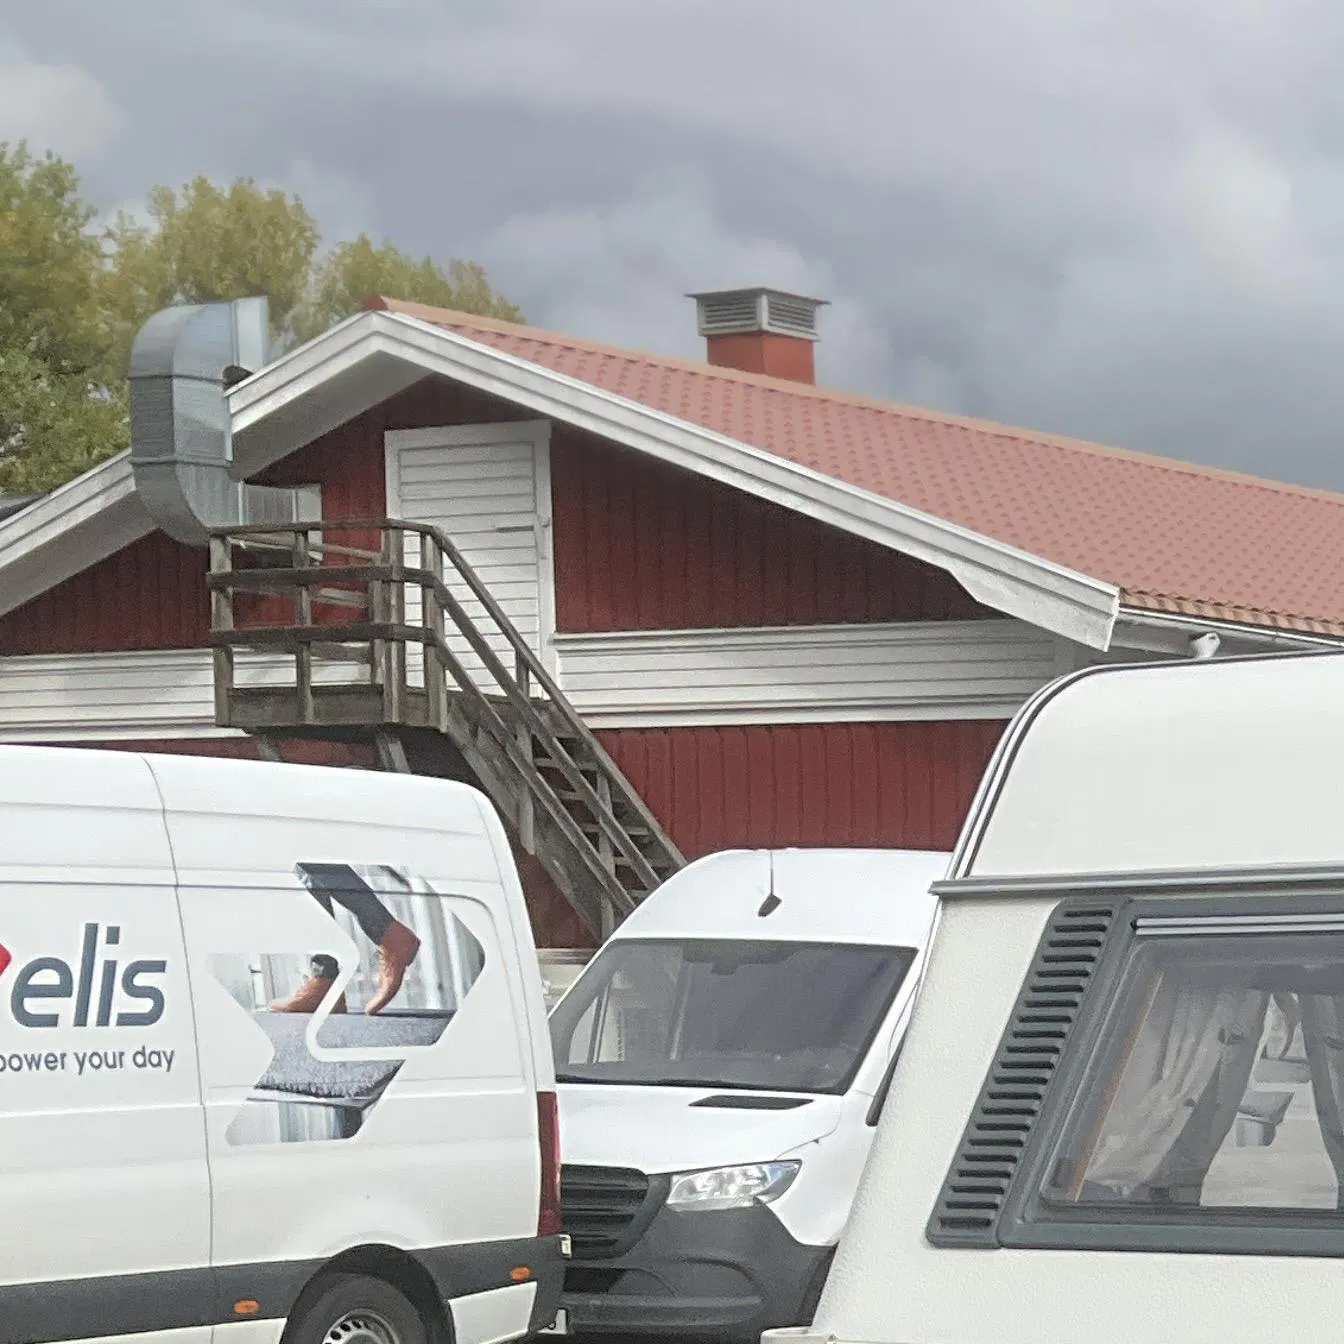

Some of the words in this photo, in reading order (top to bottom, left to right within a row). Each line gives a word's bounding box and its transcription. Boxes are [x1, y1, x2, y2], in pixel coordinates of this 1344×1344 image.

[11, 922, 168, 1028] elis
[74, 1051, 125, 1076] your
[132, 1045, 175, 1073] day
